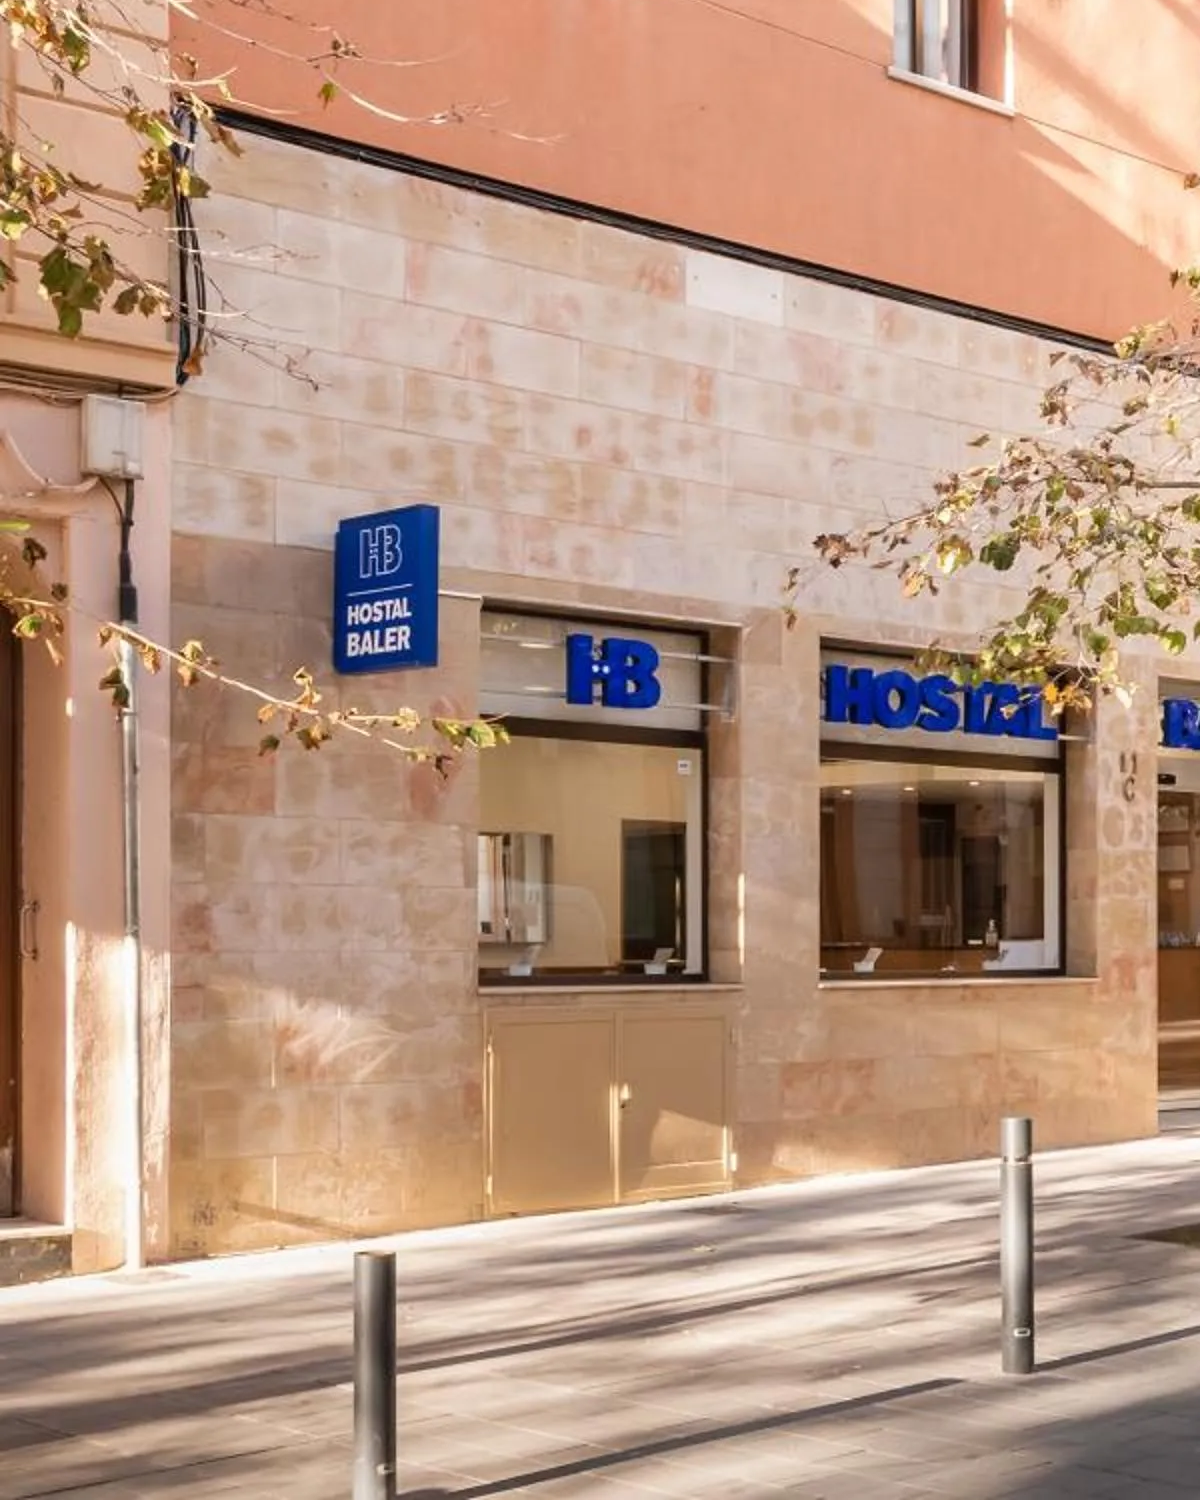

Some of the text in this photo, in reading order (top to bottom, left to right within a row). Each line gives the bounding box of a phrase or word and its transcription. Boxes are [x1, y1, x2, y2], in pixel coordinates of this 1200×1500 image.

[359, 524, 403, 579] HB
[347, 597, 412, 626] HOSTAL
[346, 626, 411, 657] BALER
[566, 633, 662, 709] HB
[825, 664, 1058, 740] HOSTAL
